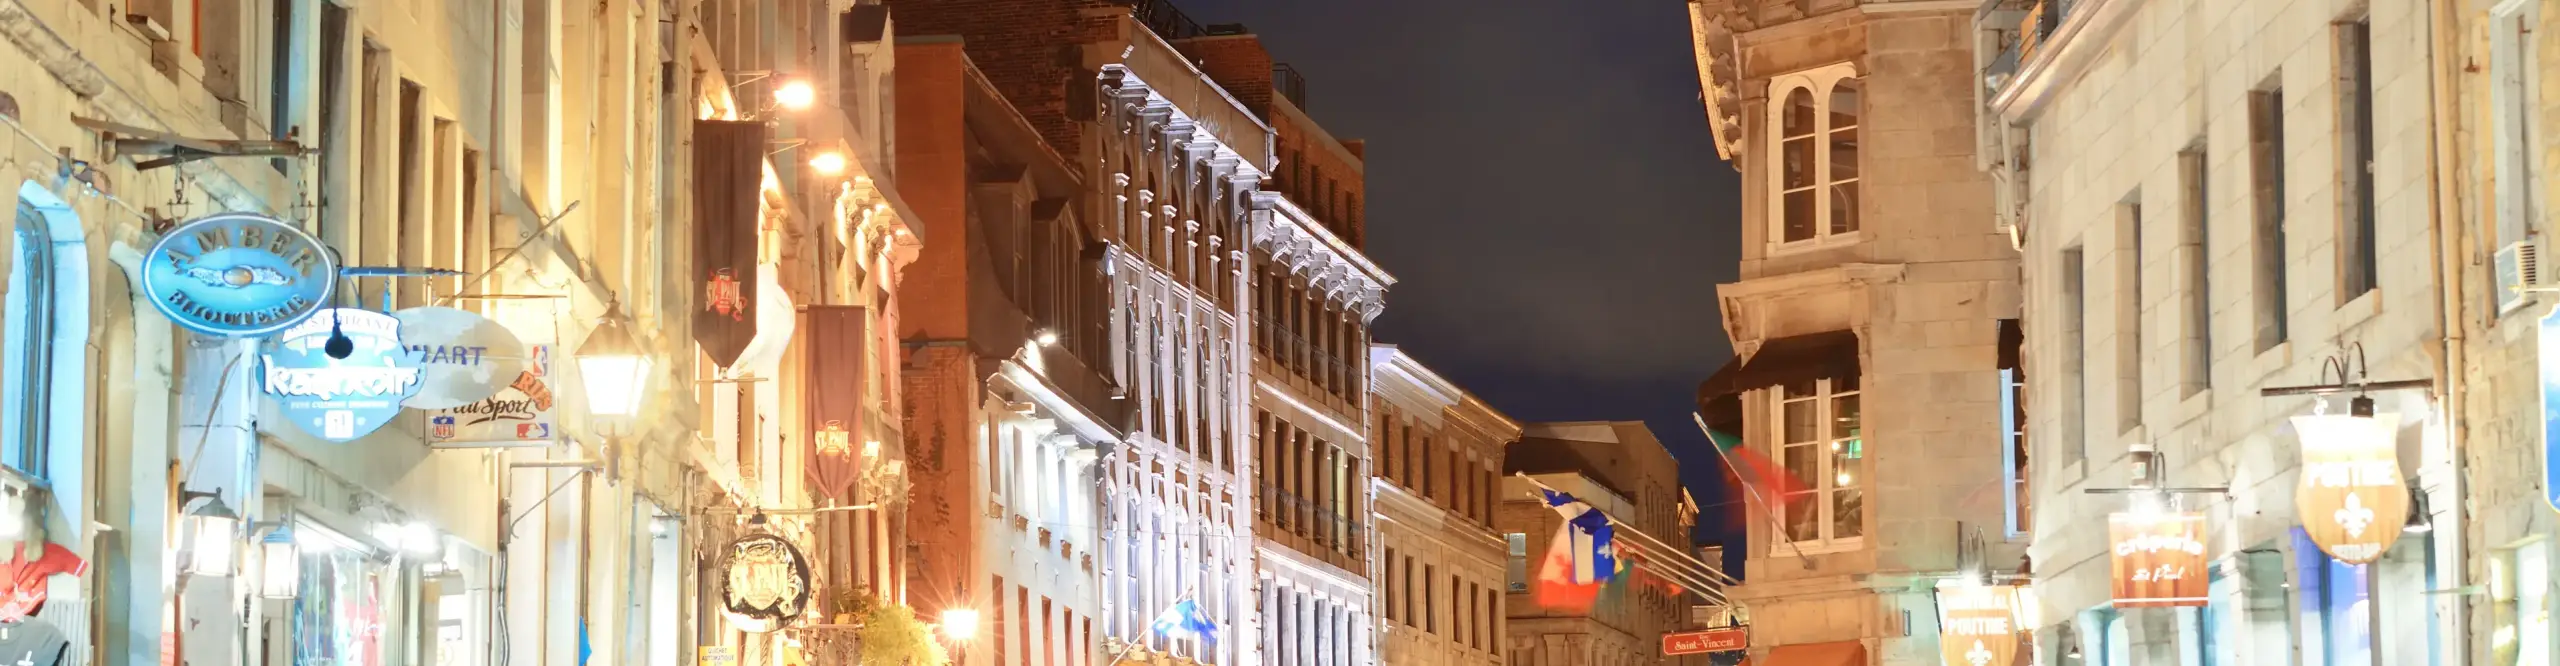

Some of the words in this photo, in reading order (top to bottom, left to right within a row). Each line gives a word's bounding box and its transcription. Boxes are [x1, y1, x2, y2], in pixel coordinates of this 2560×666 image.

[166, 226, 319, 277] AMBER
[168, 289, 306, 325] BIJOUTERIE
[481, 395, 533, 421] Sport
[435, 424, 453, 436] NFL
[1947, 617, 2009, 636] POUTINE
[1674, 638, 1735, 651] Saint-Vincent
